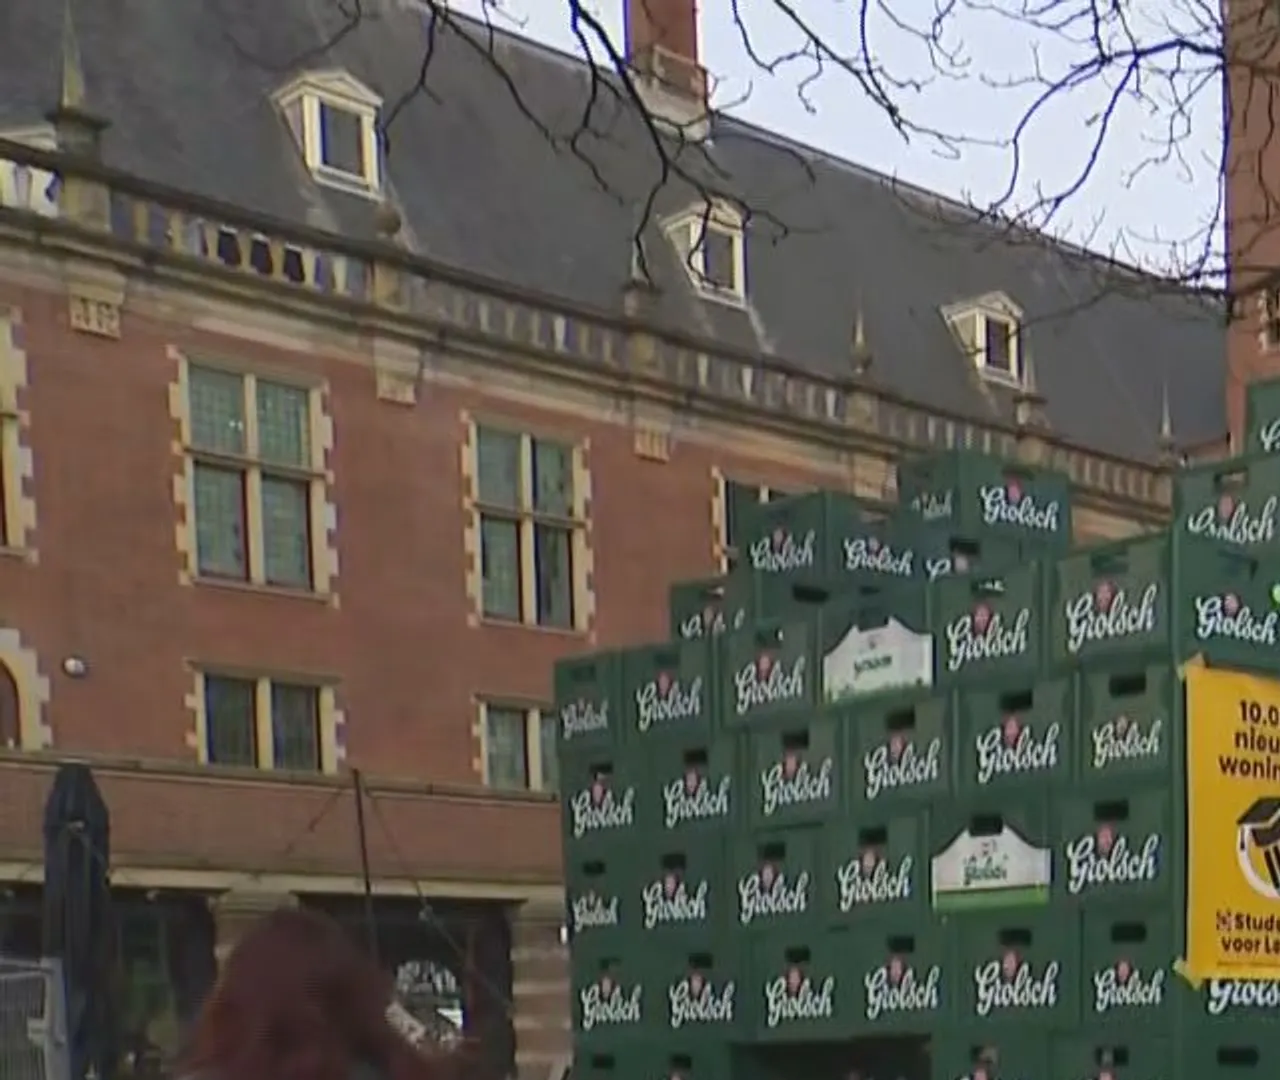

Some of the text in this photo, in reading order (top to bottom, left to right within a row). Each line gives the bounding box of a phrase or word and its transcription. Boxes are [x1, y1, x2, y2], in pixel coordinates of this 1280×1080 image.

[981, 486, 1058, 531] Grolsch
[844, 538, 912, 575] Grolsch
[947, 608, 1029, 670] Grolsch
[1066, 584, 1156, 652] Grolsch
[1196, 594, 1277, 645] Grolsch
[637, 676, 701, 731] Grolsch
[735, 656, 804, 715] Grolsch
[865, 737, 940, 799] Grolsch
[977, 722, 1059, 783] Grolsch
[1093, 716, 1162, 768] Grolsch
[572, 788, 633, 838] Grolsch
[664, 772, 730, 828] Grolsch
[762, 756, 832, 816] Grolsch
[838, 851, 911, 912] Grolsch
[1067, 834, 1158, 893] Grolsch
[643, 876, 707, 928] Grolsch
[739, 865, 808, 924] Grolsch
[1221, 937, 1262, 954] voor
[670, 975, 734, 1028] Grolsch
[766, 969, 833, 1027] Grolsch
[865, 958, 939, 1019] Grolsch
[975, 961, 1058, 1015] Grolsch
[1095, 966, 1163, 1013] Grolsch
